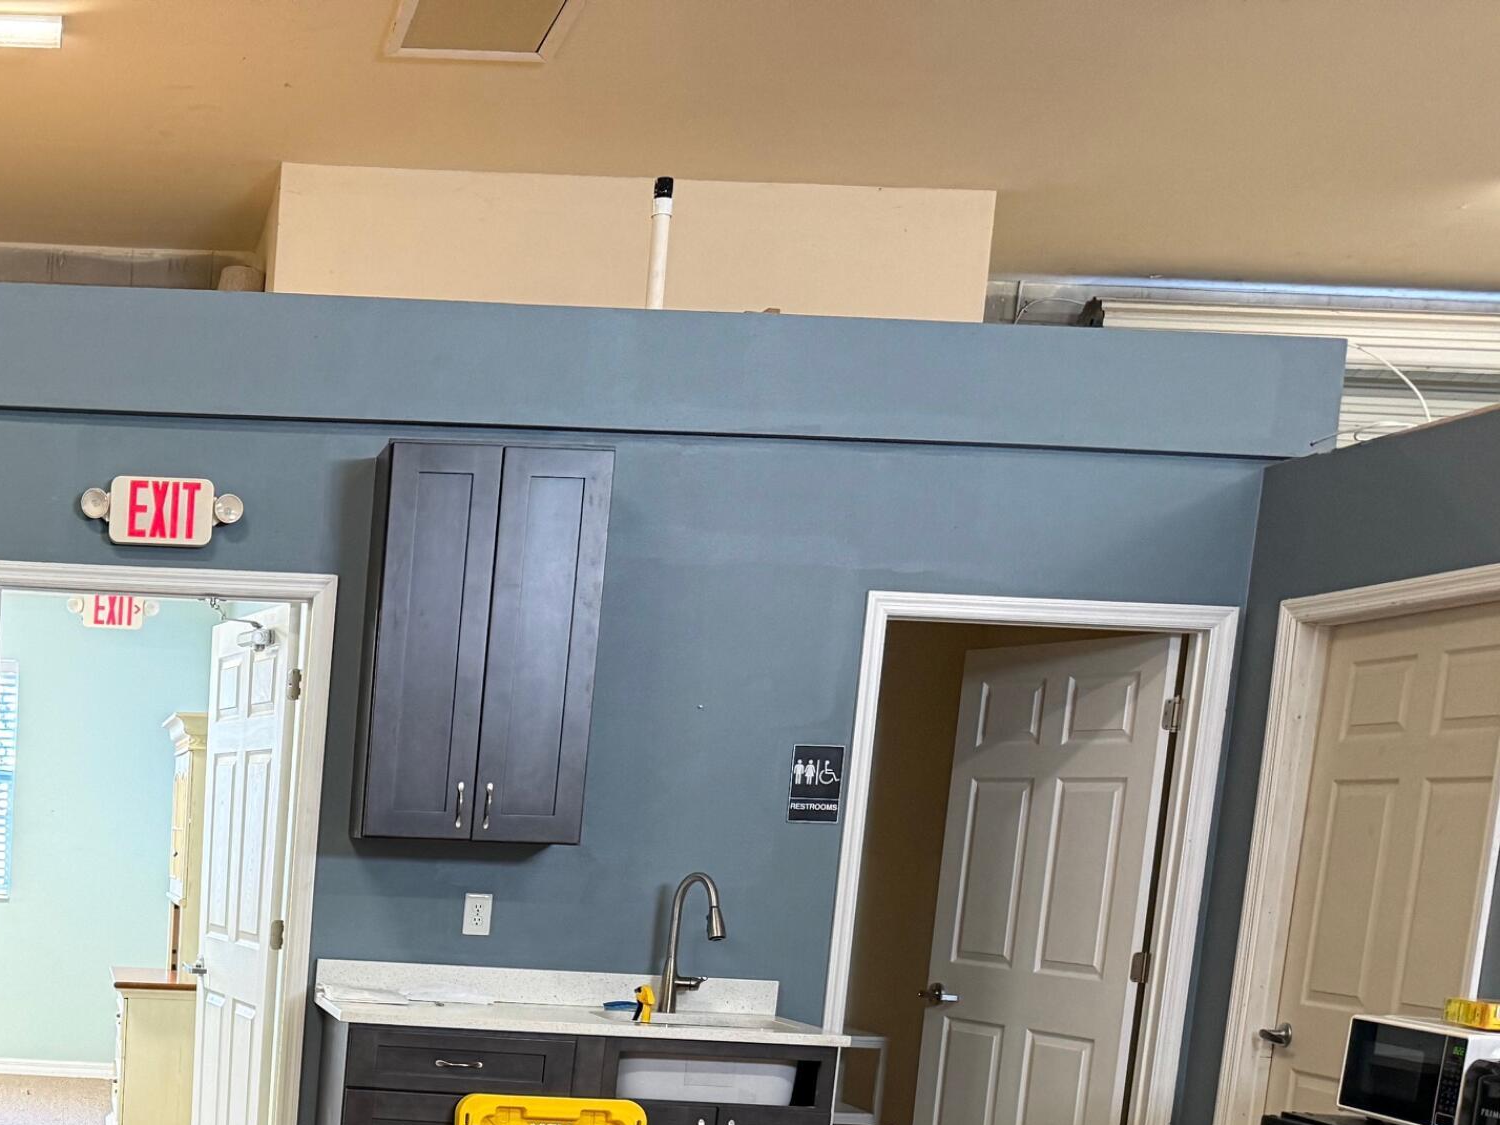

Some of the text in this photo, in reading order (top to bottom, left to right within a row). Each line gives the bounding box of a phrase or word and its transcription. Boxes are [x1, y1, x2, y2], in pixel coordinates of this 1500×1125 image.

[127, 480, 201, 539] EXIT
[93, 595, 133, 626] EXIT
[790, 802, 838, 811] RESTROOMS
[1480, 1107, 1500, 1119] PRIM
